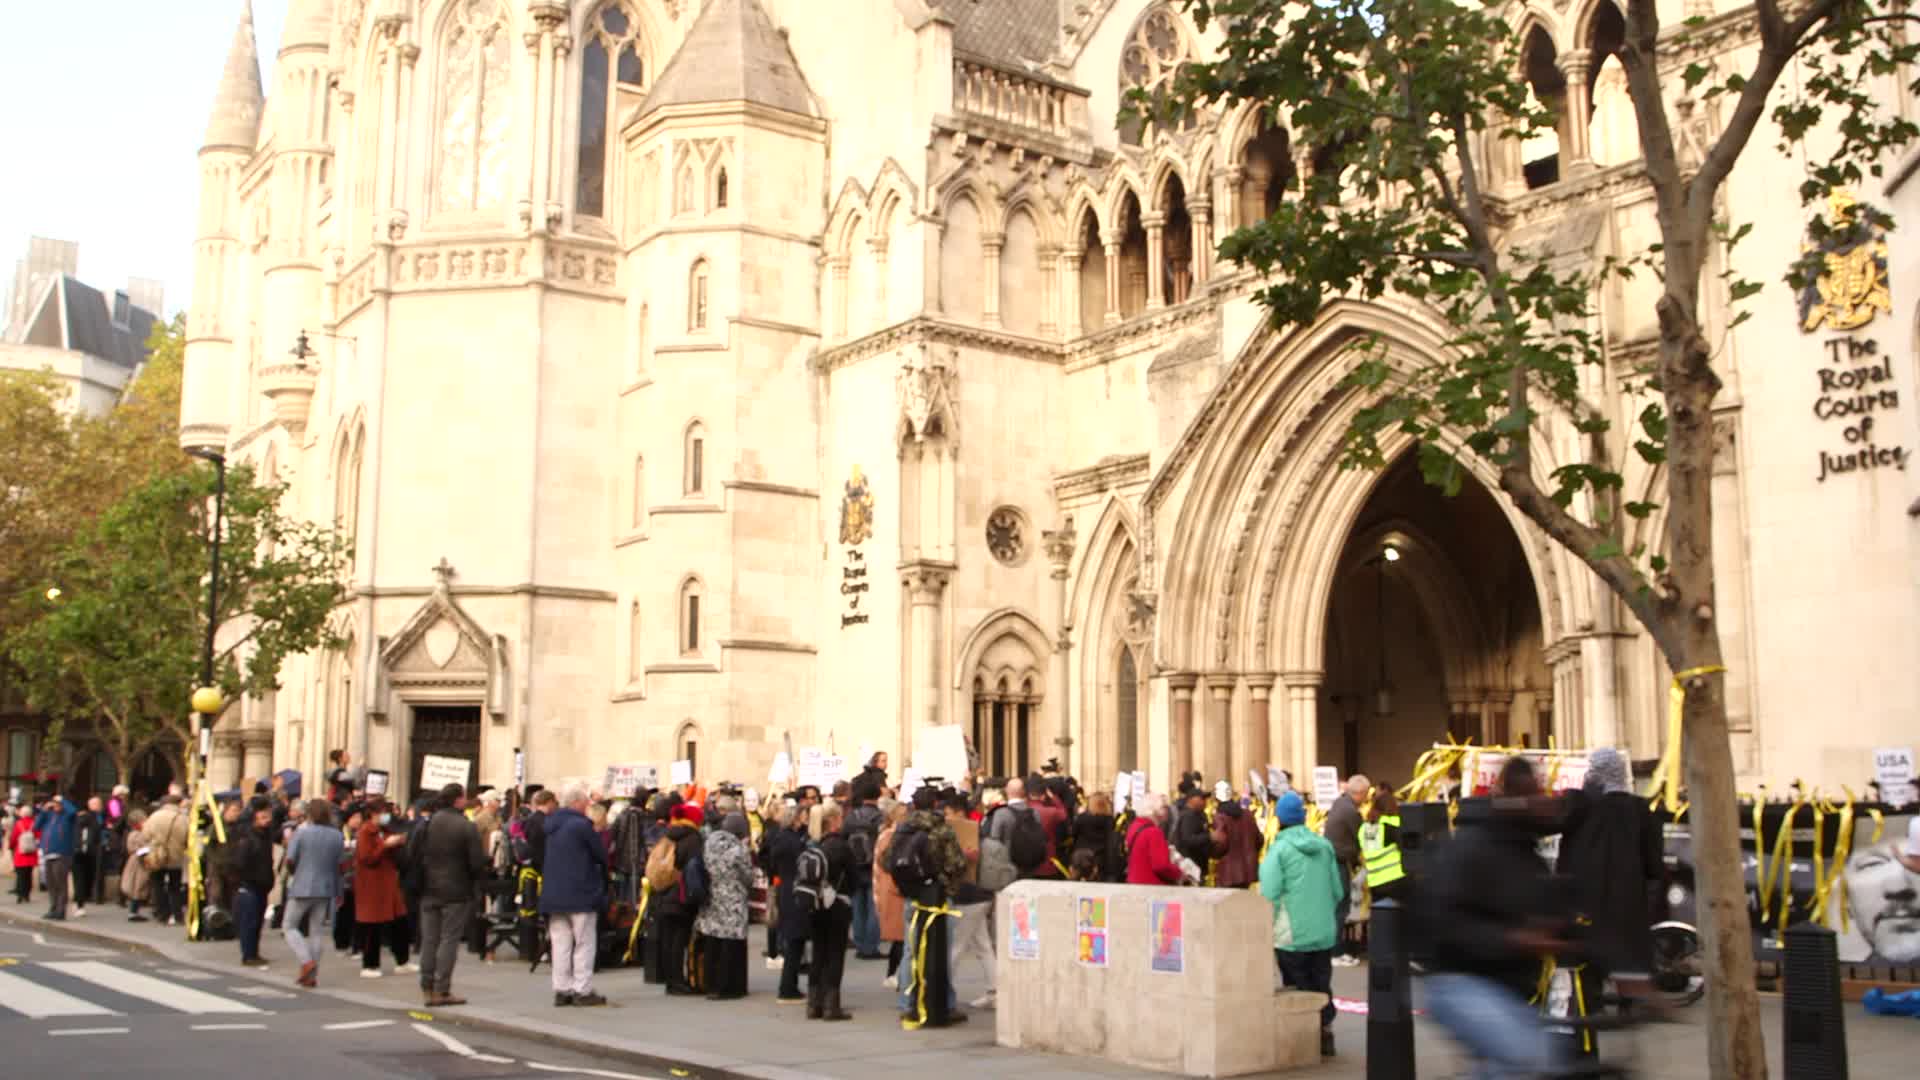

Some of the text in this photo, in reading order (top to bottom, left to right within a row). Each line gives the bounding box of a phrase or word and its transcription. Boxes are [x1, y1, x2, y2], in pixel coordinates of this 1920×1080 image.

[1825, 336, 1877, 362] The
[1817, 355, 1892, 392] Royal
[1814, 390, 1898, 420] Courts
[1844, 416, 1874, 443] of
[1817, 444, 1904, 482] Justice
[1877, 754, 1910, 768] USA
